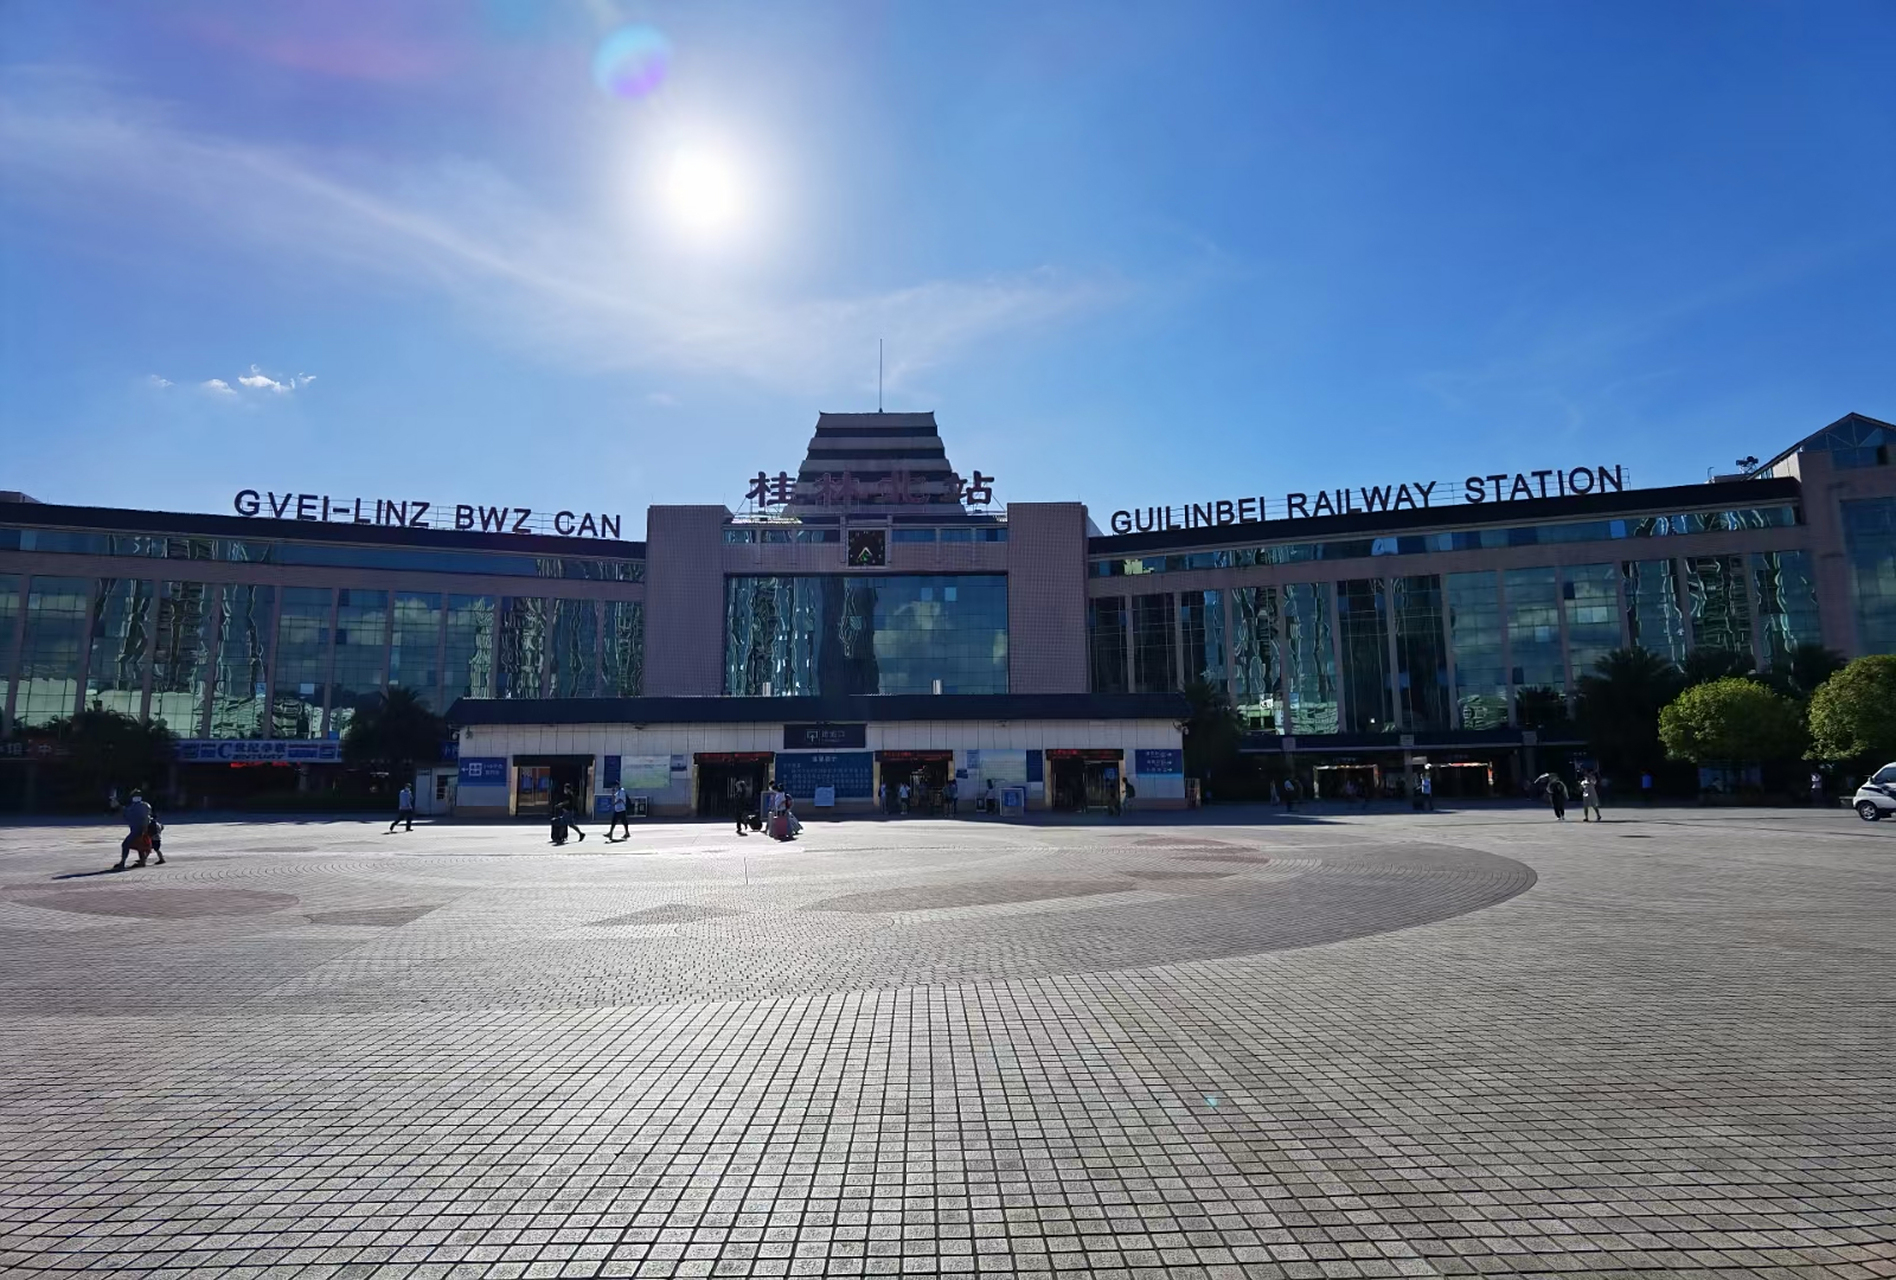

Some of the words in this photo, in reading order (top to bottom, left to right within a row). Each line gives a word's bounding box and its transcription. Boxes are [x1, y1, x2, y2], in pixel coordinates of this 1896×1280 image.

[234, 489, 430, 527] GVEI-LINZ
[455, 504, 531, 534] BWZ
[554, 510, 621, 539] CAN
[745, 471, 994, 507] 桂林北站
[1111, 496, 1266, 534] GUILINBEI
[1287, 480, 1437, 519] RAILWAY
[1465, 465, 1622, 503] STATION
